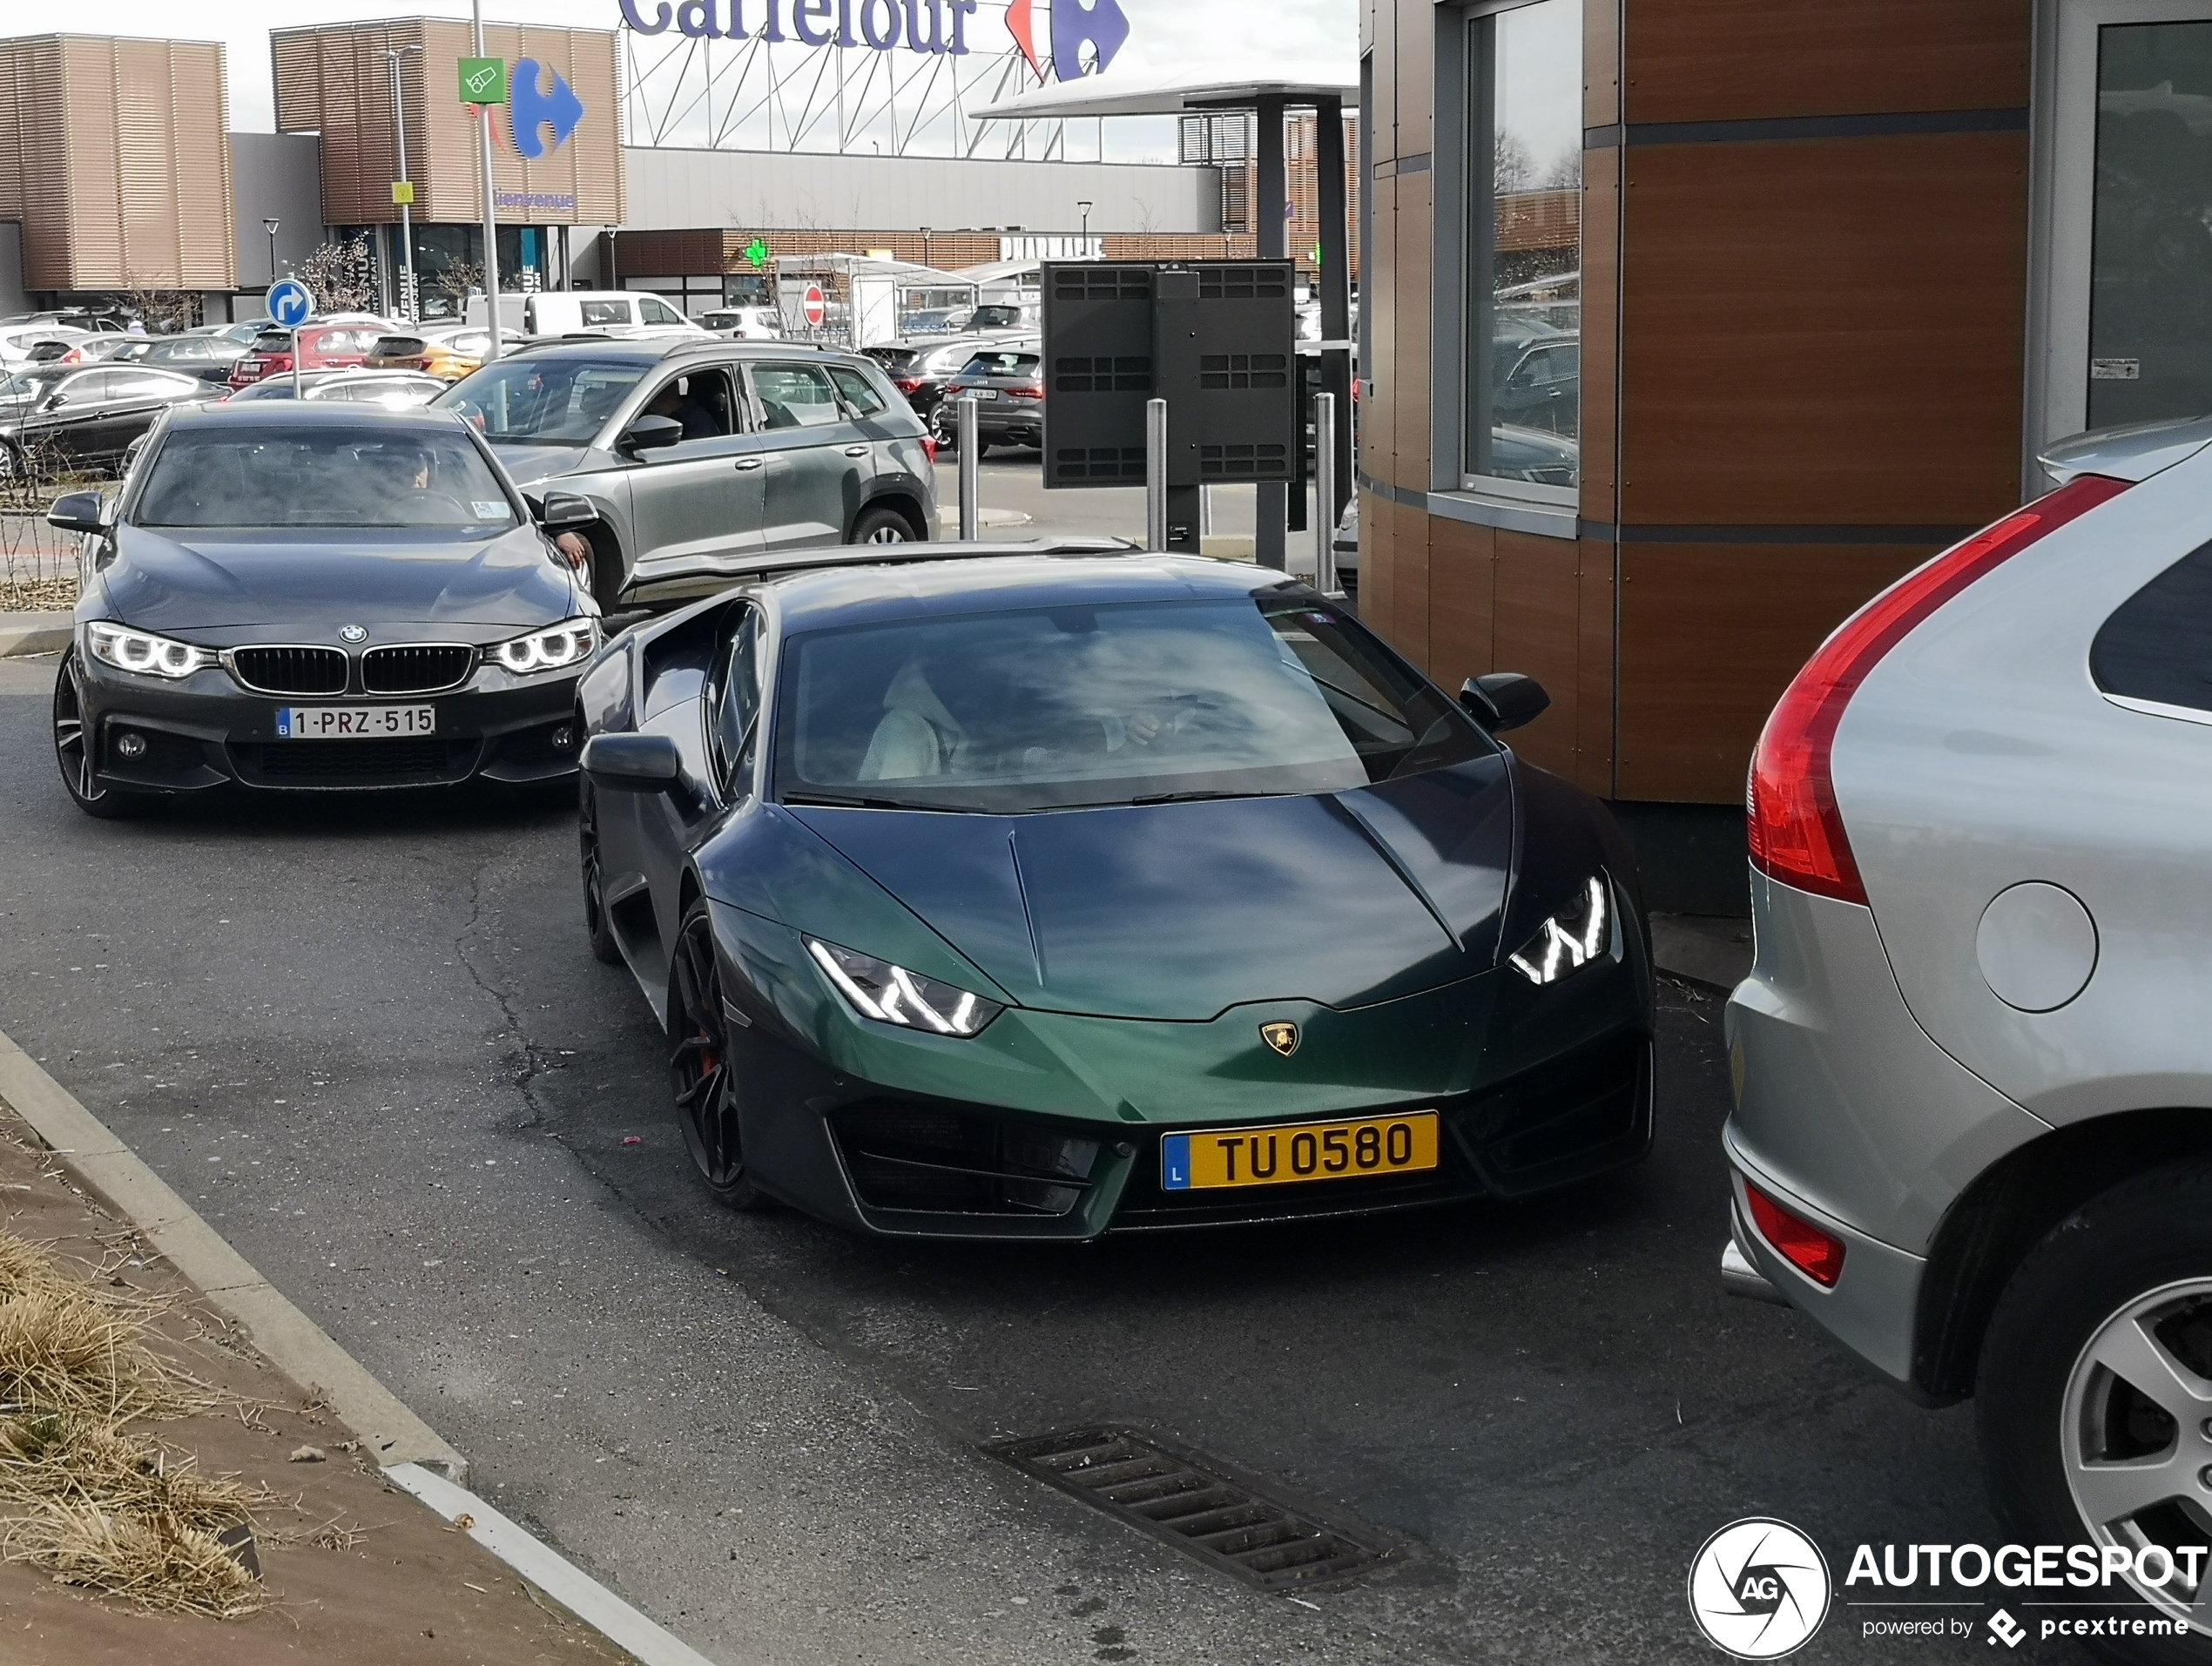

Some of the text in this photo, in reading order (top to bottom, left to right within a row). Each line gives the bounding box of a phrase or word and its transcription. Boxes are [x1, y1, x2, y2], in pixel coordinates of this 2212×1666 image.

[491, 190, 576, 210] ienvenue
[279, 709, 432, 735] B 1-PRZ-515
[1172, 1123, 1413, 1182] L TU 0580
